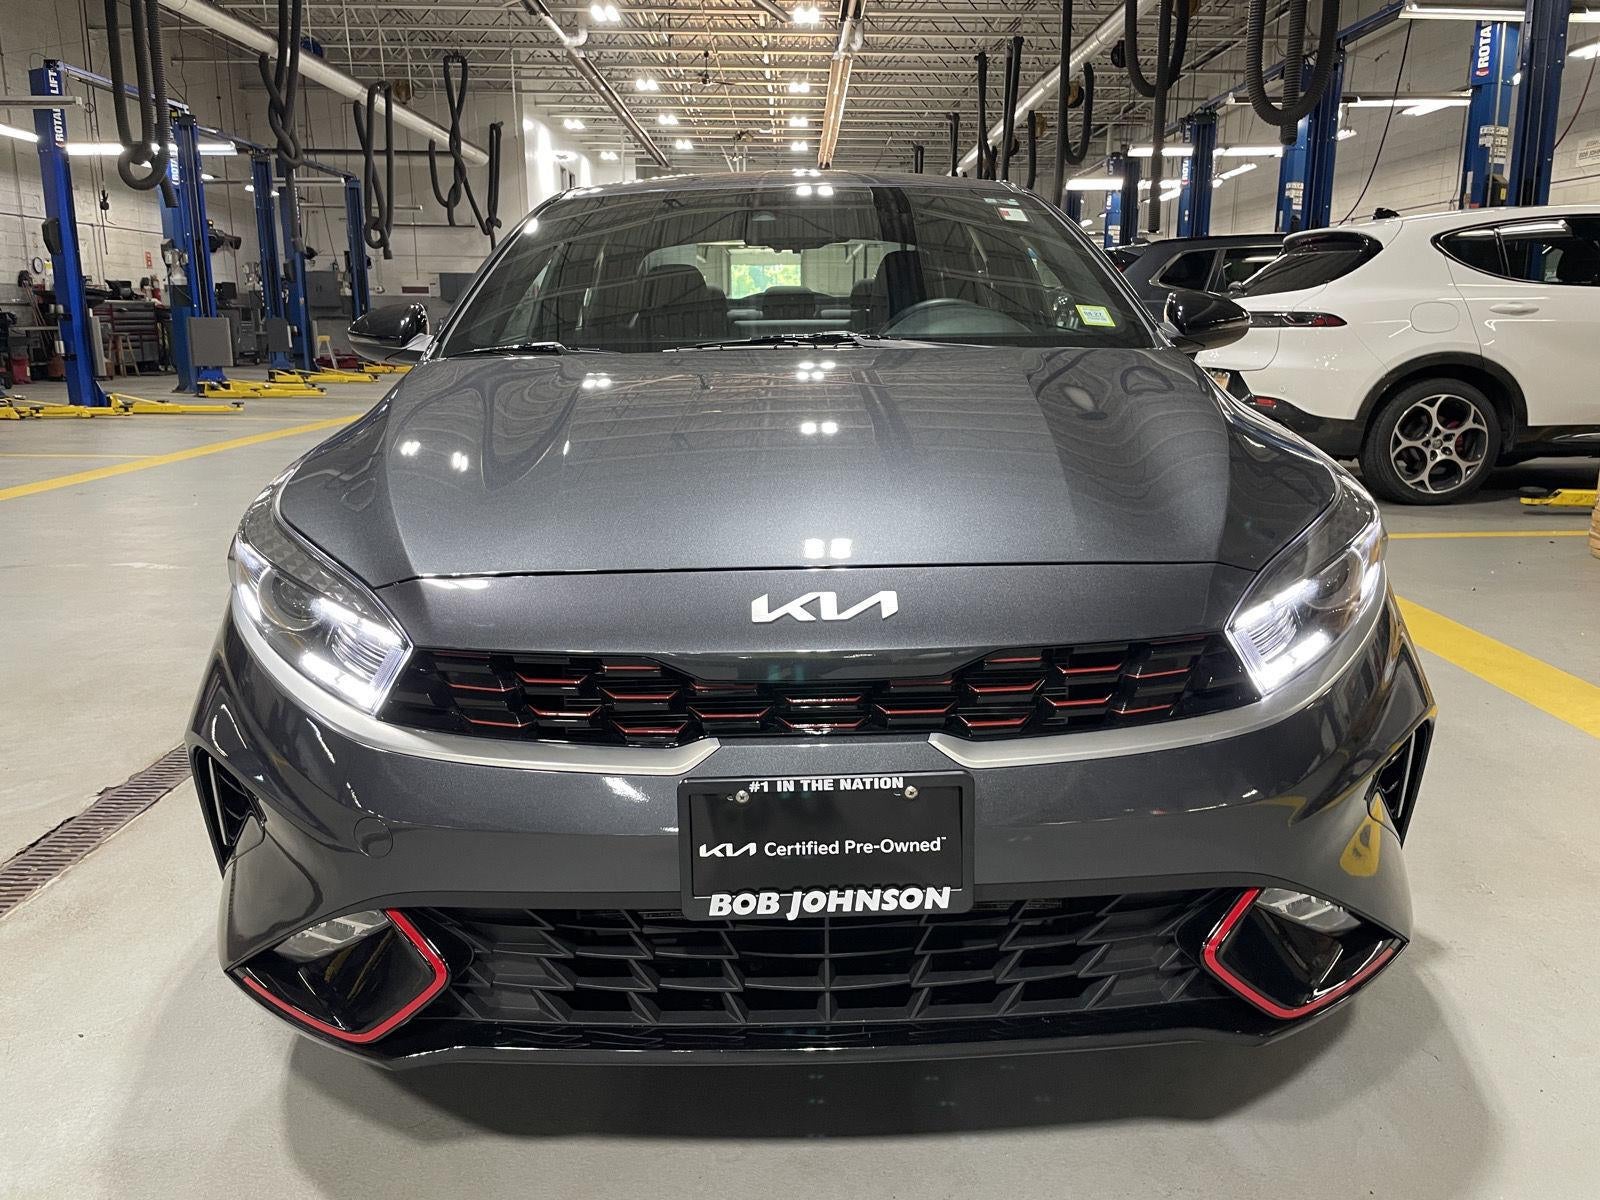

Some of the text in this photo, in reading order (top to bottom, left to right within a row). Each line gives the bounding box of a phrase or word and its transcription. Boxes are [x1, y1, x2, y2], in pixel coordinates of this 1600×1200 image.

[1477, 20, 1493, 69] ROTA
[48, 70, 65, 142] ROTA LIFT
[751, 590, 899, 623] KIA
[749, 776, 904, 793] #1 IN THE NATION
[699, 842, 757, 858] KIA
[763, 840, 840, 857] Certified
[708, 886, 951, 921] BOB JOHNSON
